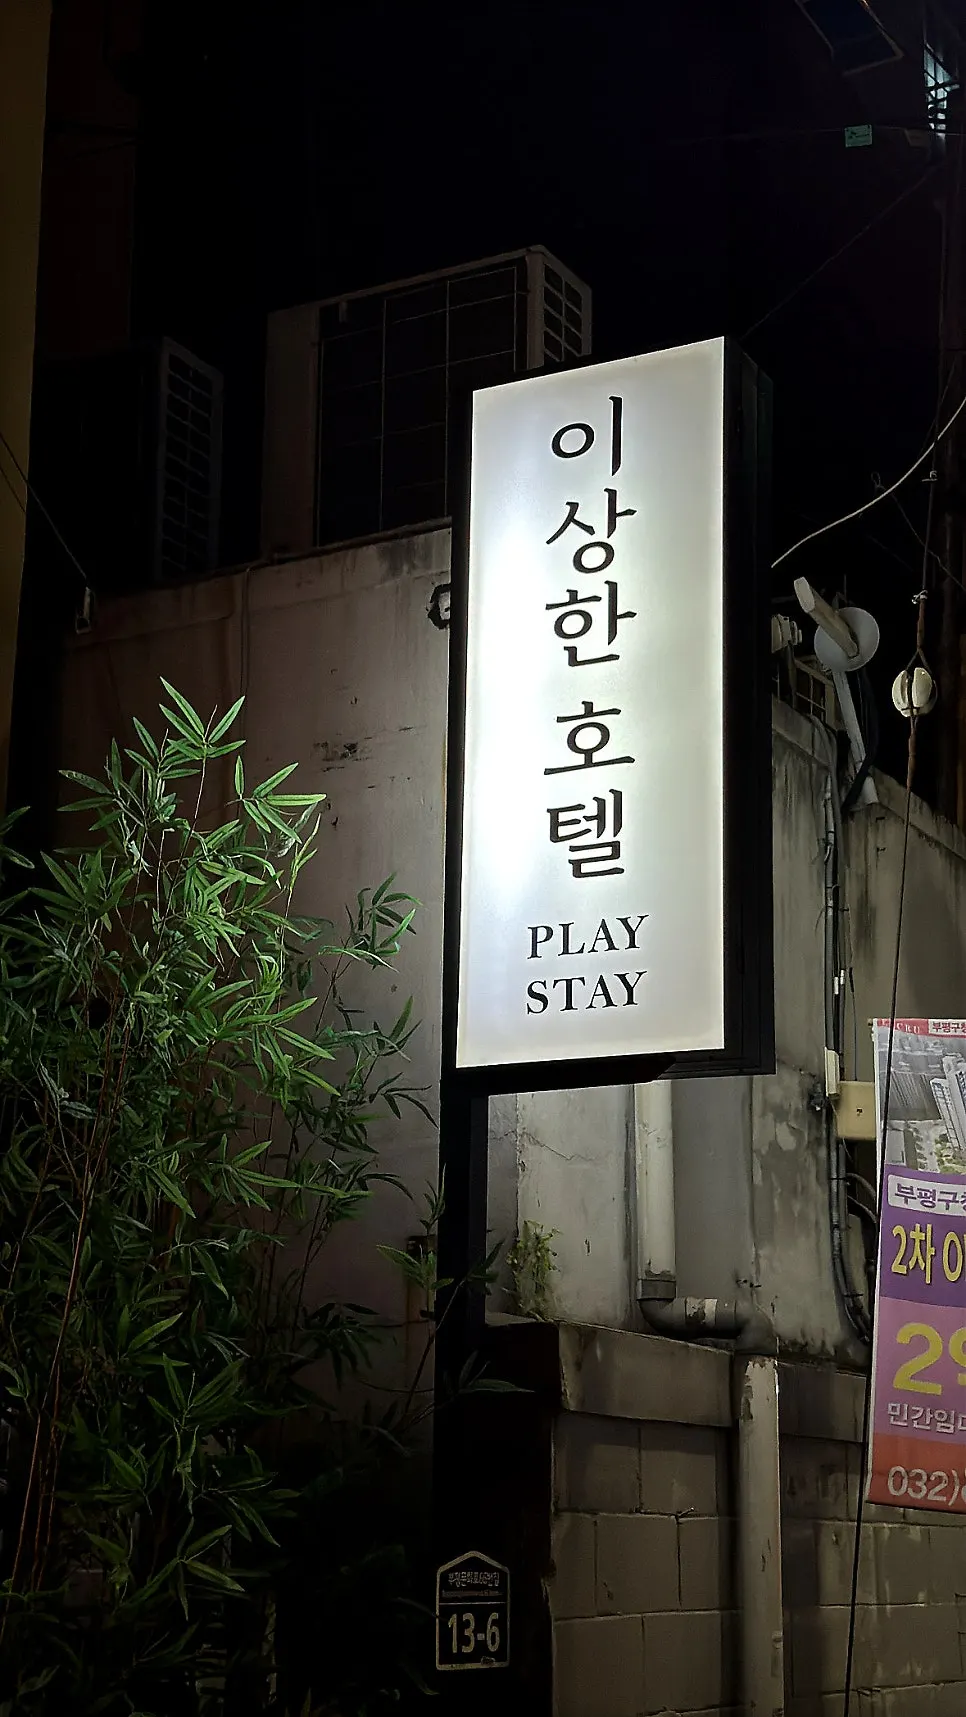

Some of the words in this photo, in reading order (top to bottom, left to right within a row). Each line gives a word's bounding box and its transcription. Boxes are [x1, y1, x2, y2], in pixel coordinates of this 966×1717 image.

[545, 395, 638, 668] 이상한
[543, 700, 636, 879] 호텔
[527, 914, 650, 960] PLAY
[526, 970, 648, 1015] STAY
[887, 1465, 966, 1507] 032)
[448, 1612, 500, 1653] 13-6
